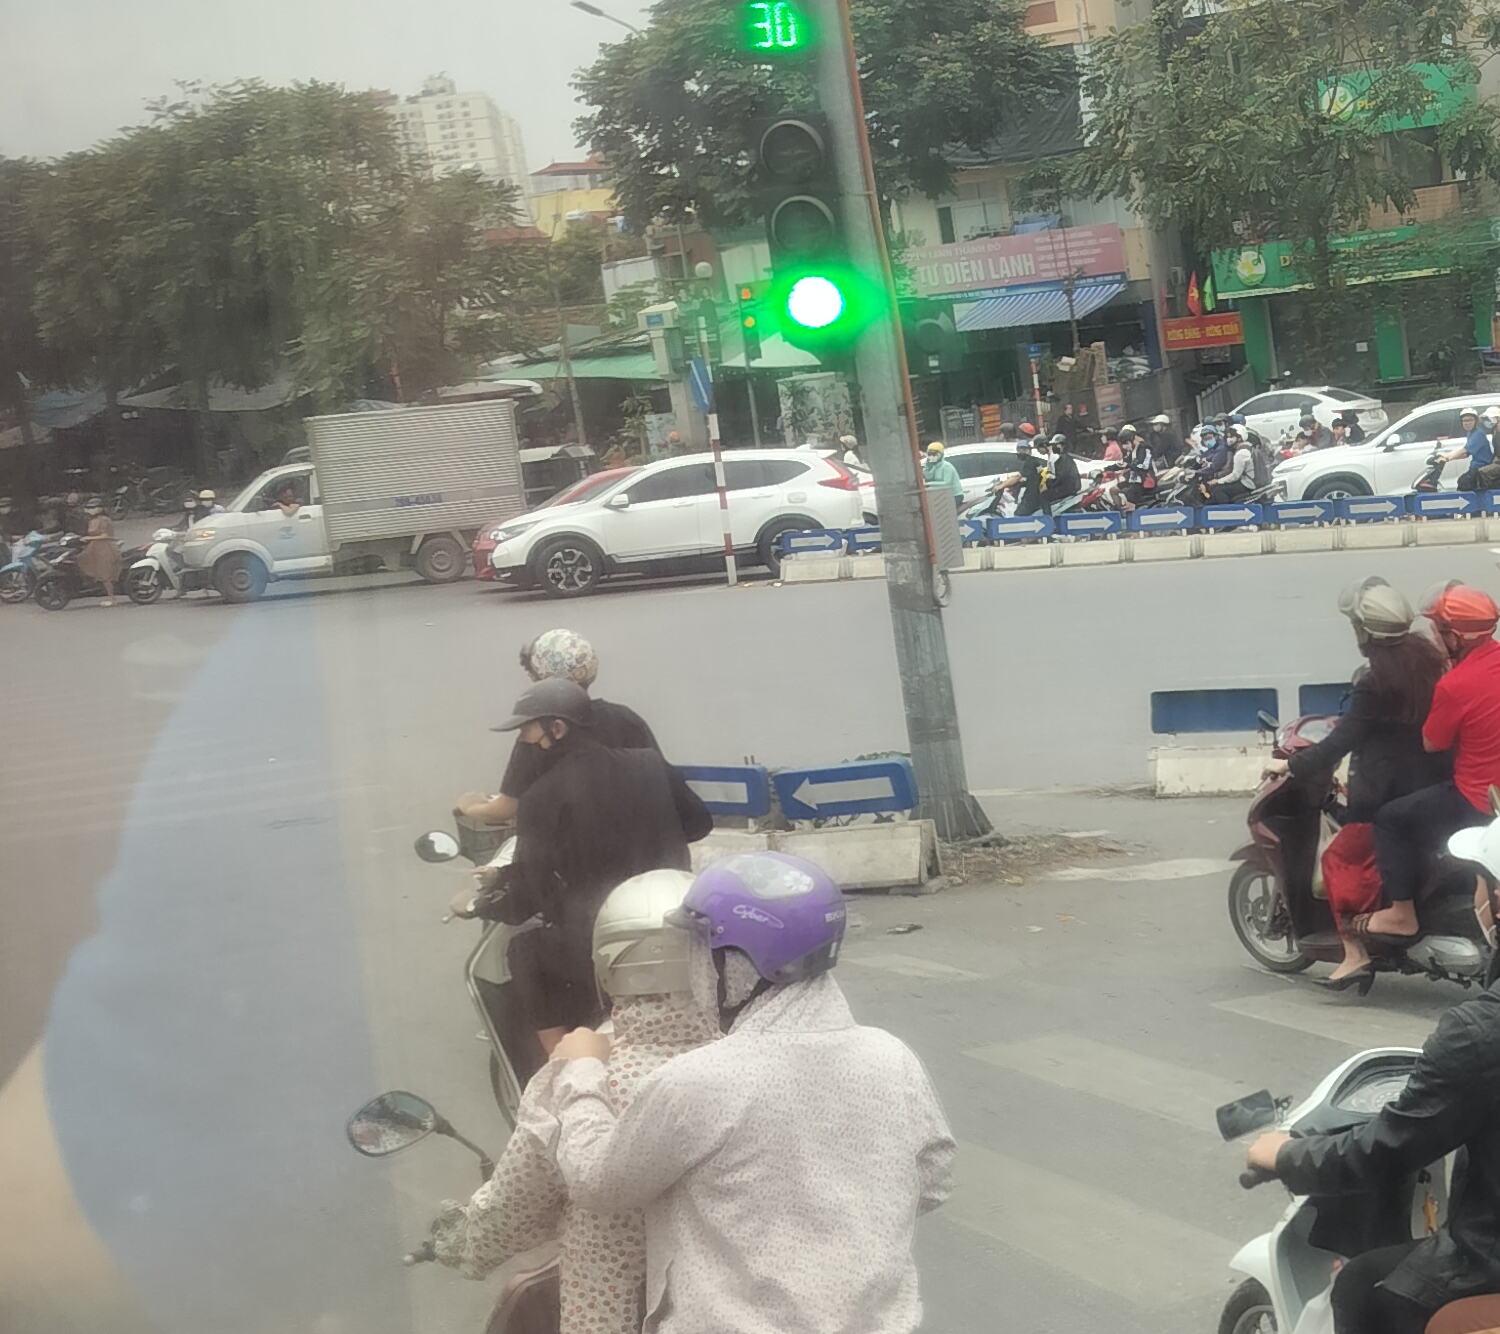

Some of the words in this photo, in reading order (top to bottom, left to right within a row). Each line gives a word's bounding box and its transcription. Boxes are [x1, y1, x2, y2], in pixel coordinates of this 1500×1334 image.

[750, 3, 797, 48] 30
[942, 256, 985, 289] ĐIỆN
[988, 252, 1037, 285] LẠNH
